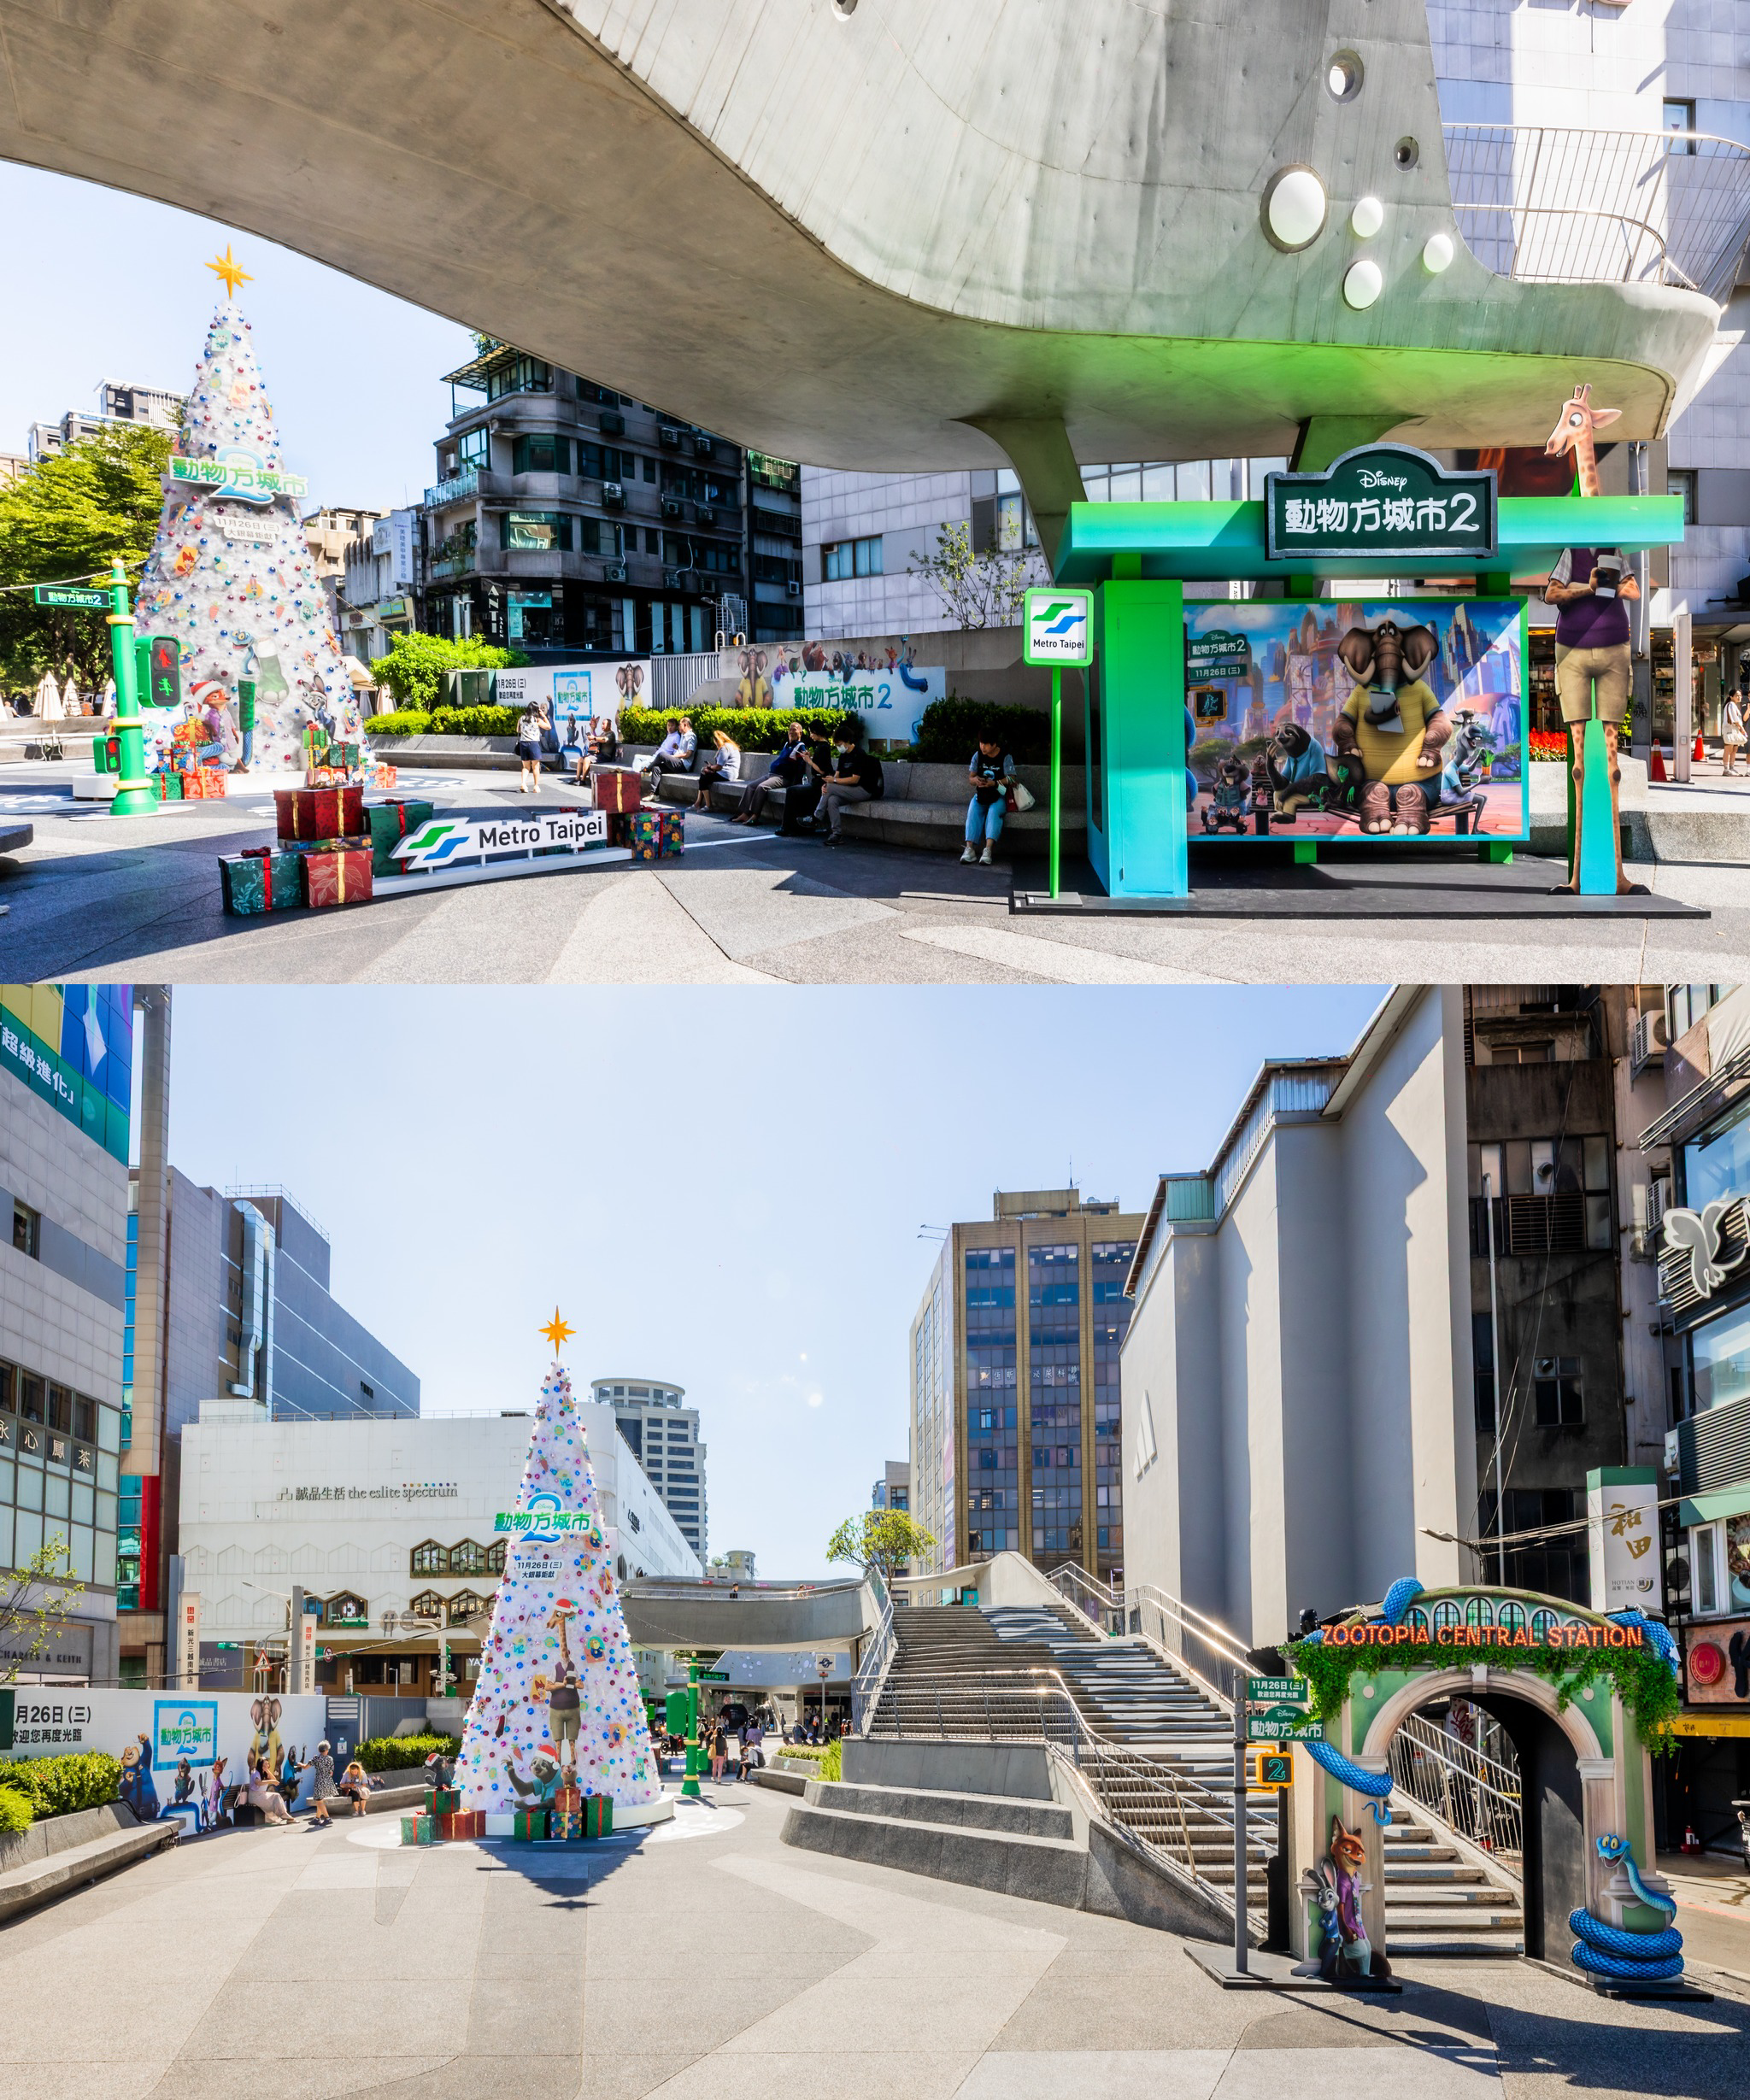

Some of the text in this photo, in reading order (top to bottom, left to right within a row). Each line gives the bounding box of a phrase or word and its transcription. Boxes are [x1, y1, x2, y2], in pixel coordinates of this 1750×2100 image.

[172, 458, 307, 496] 動物方城市
[1356, 469, 1407, 492] Disney
[1284, 492, 1480, 534] 動物方城市2
[217, 518, 280, 532] 11月26日(三)
[48, 590, 103, 606] 動物方城市2
[486, 585, 500, 633] ANTI
[1033, 638, 1084, 650] Metro Taipei
[1192, 639, 1246, 655] 動物方城市2
[1195, 666, 1241, 678] 11月26日(三)
[558, 690, 588, 703] 動物方城市
[794, 683, 893, 710] 動物方城市2
[479, 817, 603, 848] Metro Taipei
[0, 1022, 73, 1105] 超級進化」
[0, 1419, 91, 1469] 永心鳳茶
[296, 1485, 458, 1503] 誠品生活 the eslite spectrum
[494, 1512, 592, 1532] 動物方城市
[517, 1561, 563, 1569] 11月26日(三)
[522, 1570, 555, 1579] 大銀幕鉅獻
[1321, 1624, 1643, 1647] ZOOTOPIA CENTRAL STATION
[57, 1654, 81, 1663] KEITH
[1252, 1681, 1304, 1691] 11月26日(三)
[1275, 1709, 1297, 1719] Disney
[161, 1727, 212, 1745] 動物方城市
[1267, 1758, 1286, 1780] 2
